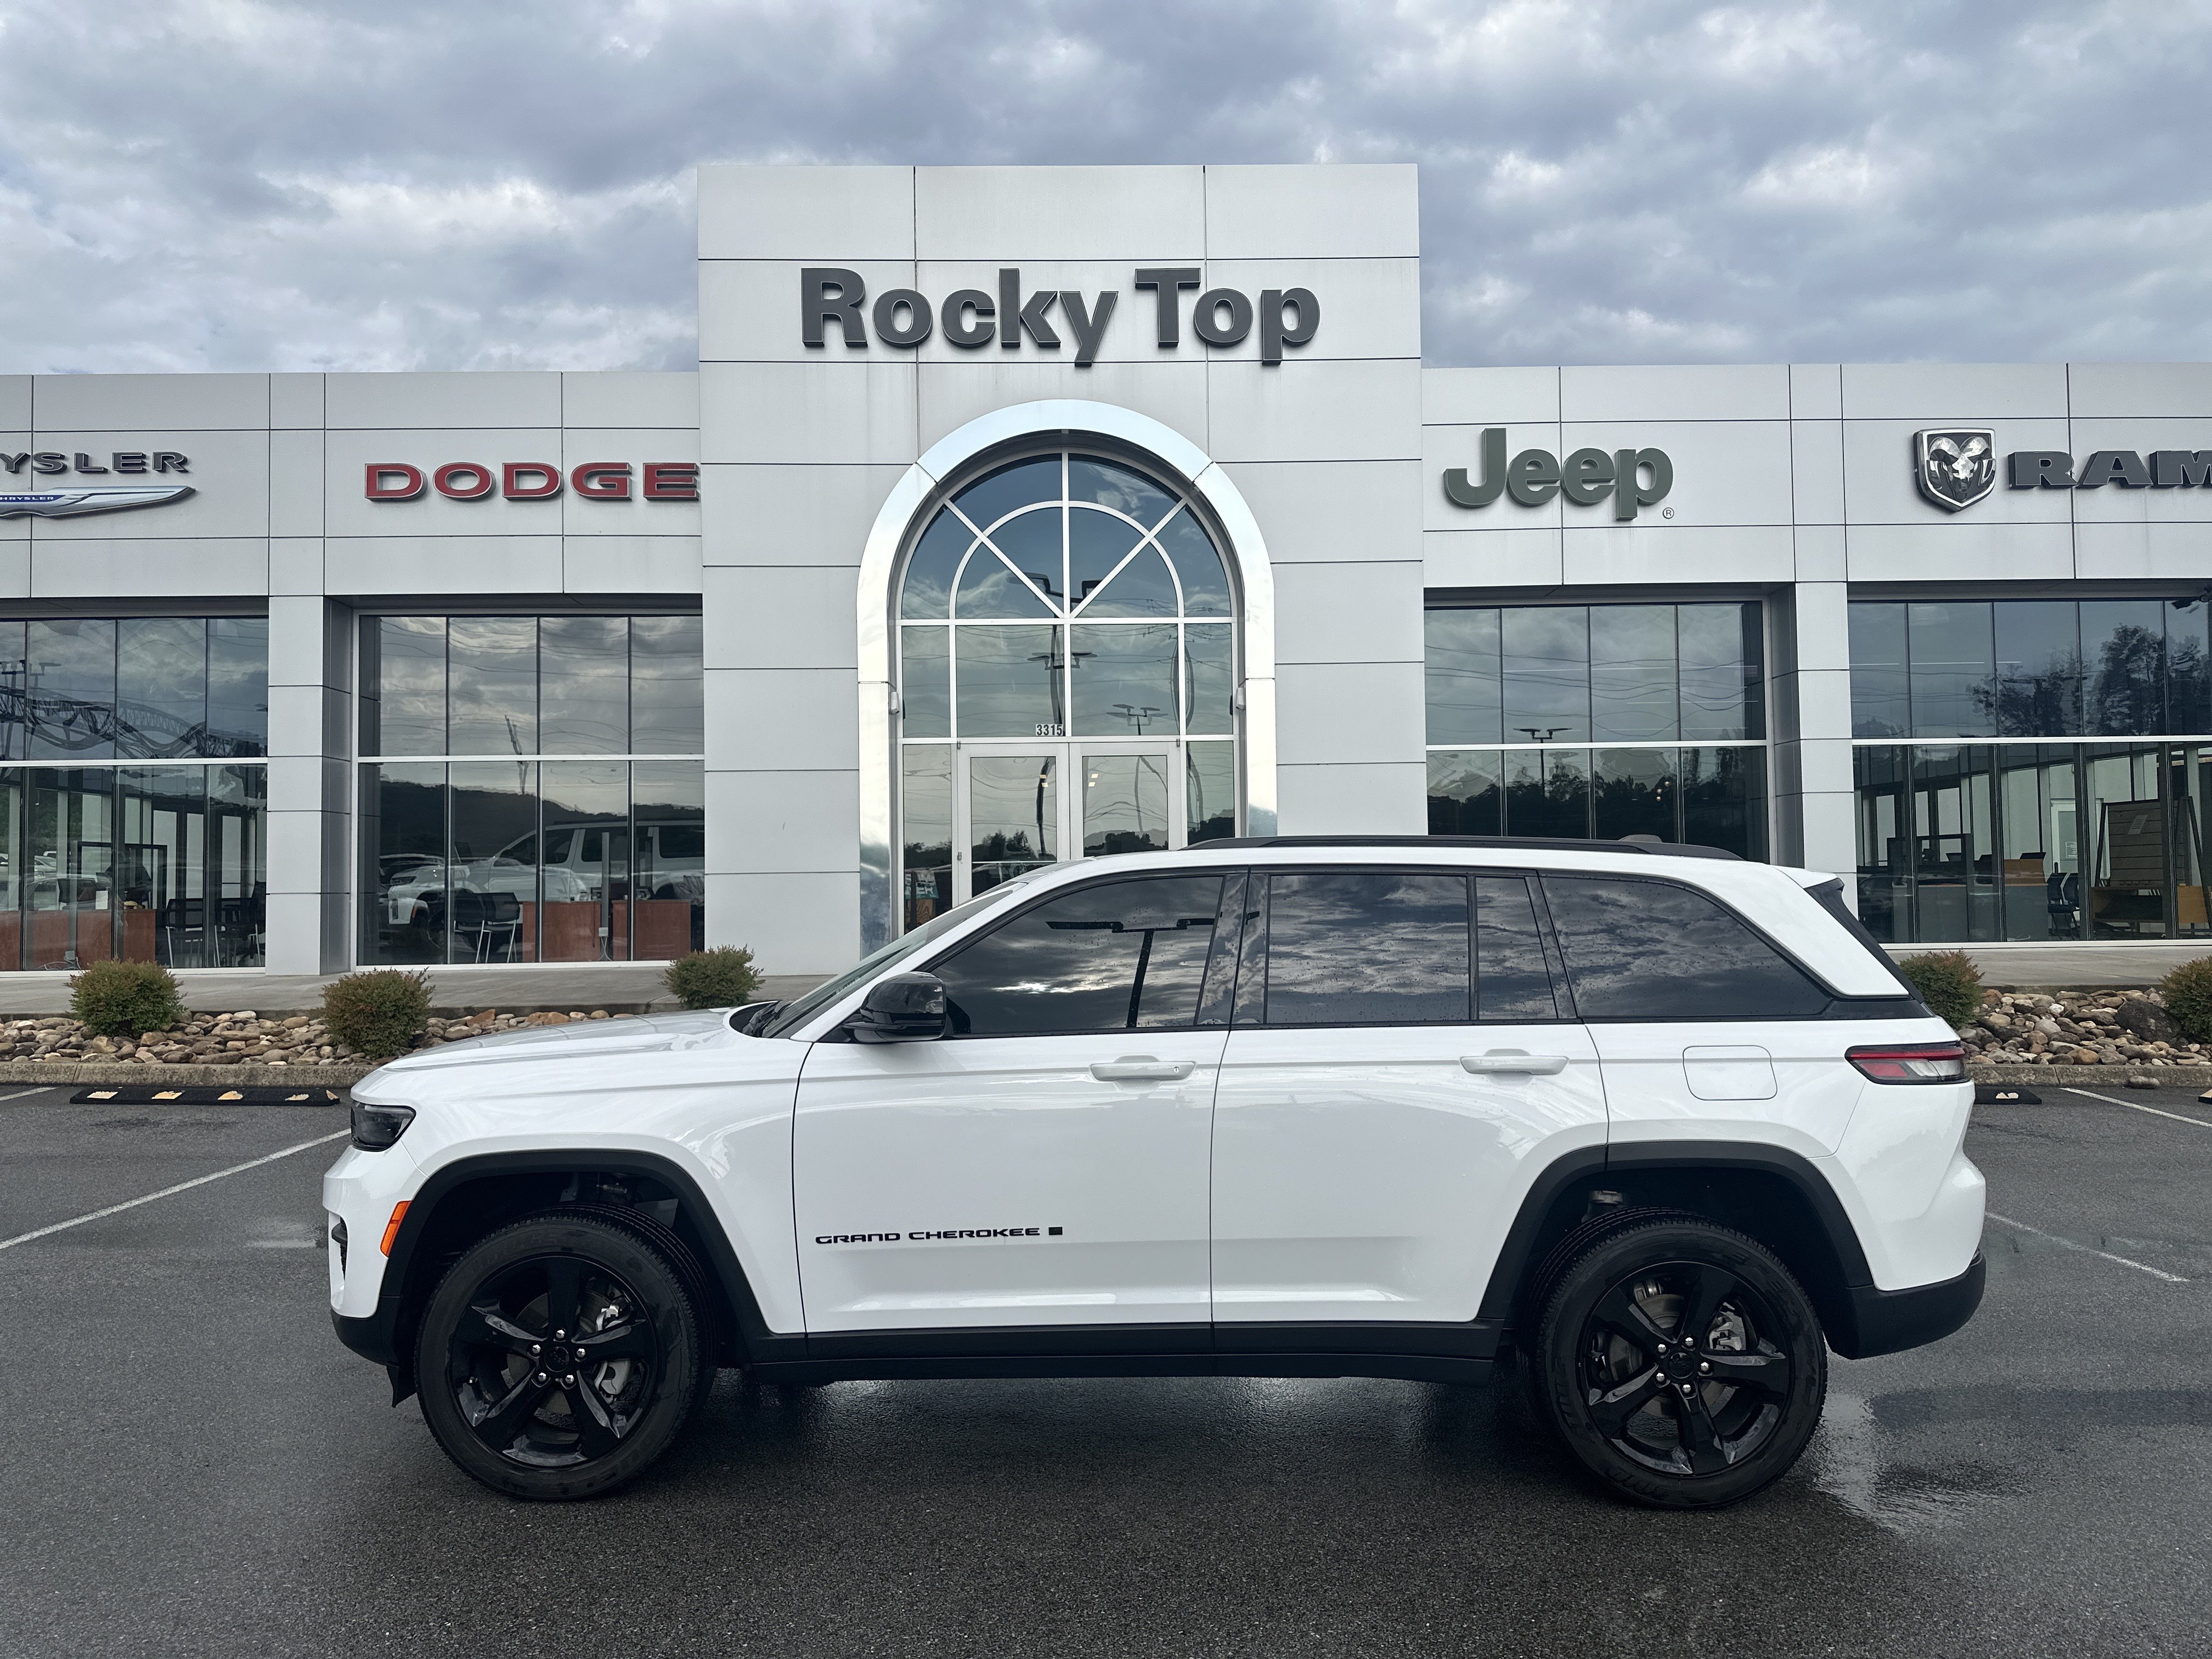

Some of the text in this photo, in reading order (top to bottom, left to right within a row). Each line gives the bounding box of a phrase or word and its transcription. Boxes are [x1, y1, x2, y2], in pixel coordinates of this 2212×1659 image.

[800, 267, 1321, 367] Rocky Top
[0, 452, 189, 473] YSLER
[364, 462, 699, 501] DODGE
[1443, 427, 1674, 521] Jeep
[2007, 450, 2212, 490] RAM
[1036, 724, 1063, 736] 3315
[815, 1227, 1041, 1244] GRAND CHEROKEE
